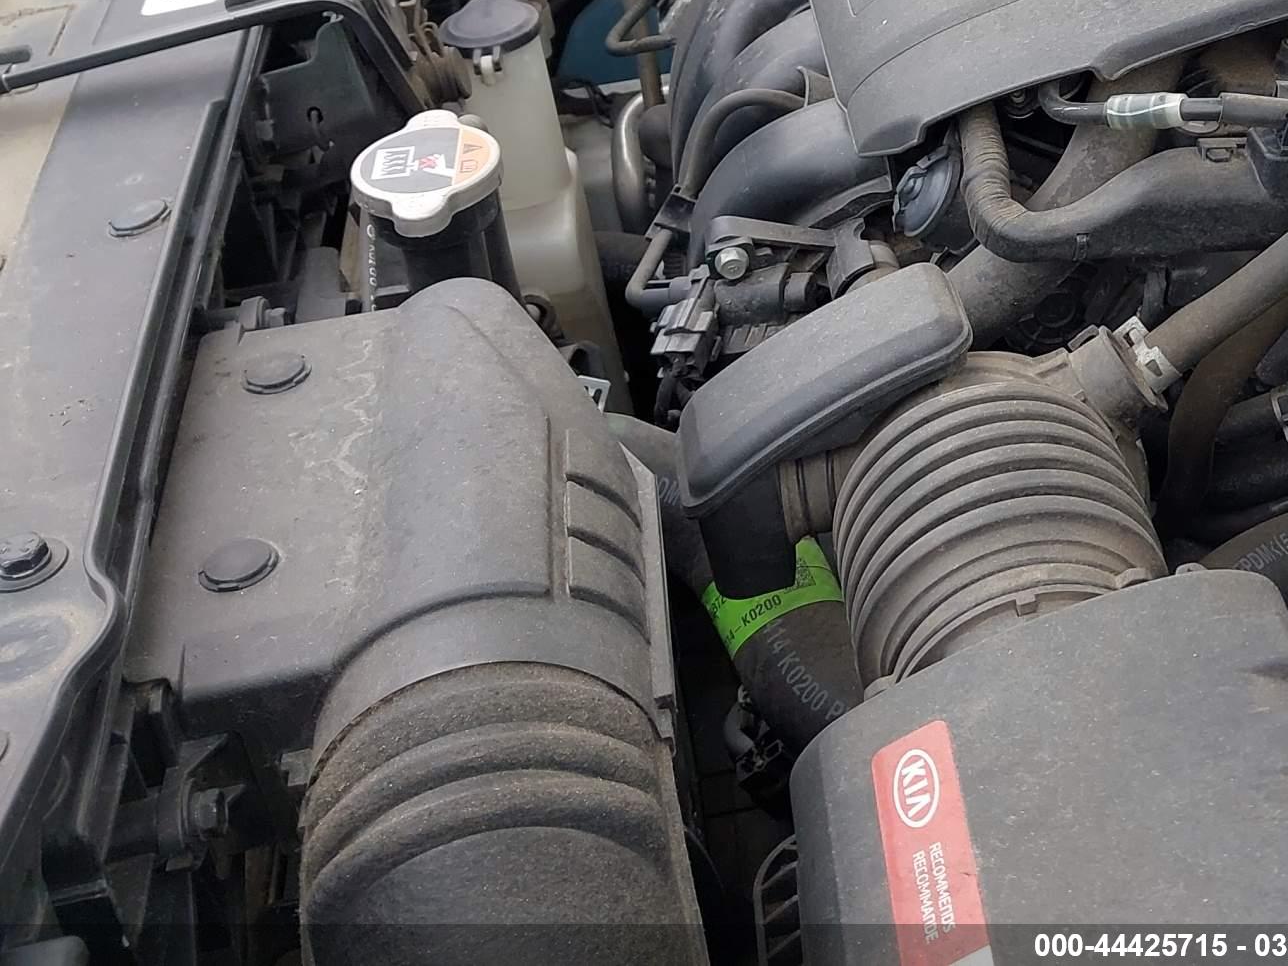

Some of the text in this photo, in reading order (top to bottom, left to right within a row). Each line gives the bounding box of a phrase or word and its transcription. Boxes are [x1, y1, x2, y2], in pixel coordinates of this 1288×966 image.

[779, 653, 828, 712] K0200
[901, 757, 932, 819] KIA
[912, 849, 939, 945] RECOMMANDE
[929, 841, 956, 934] RECOMMENDS
